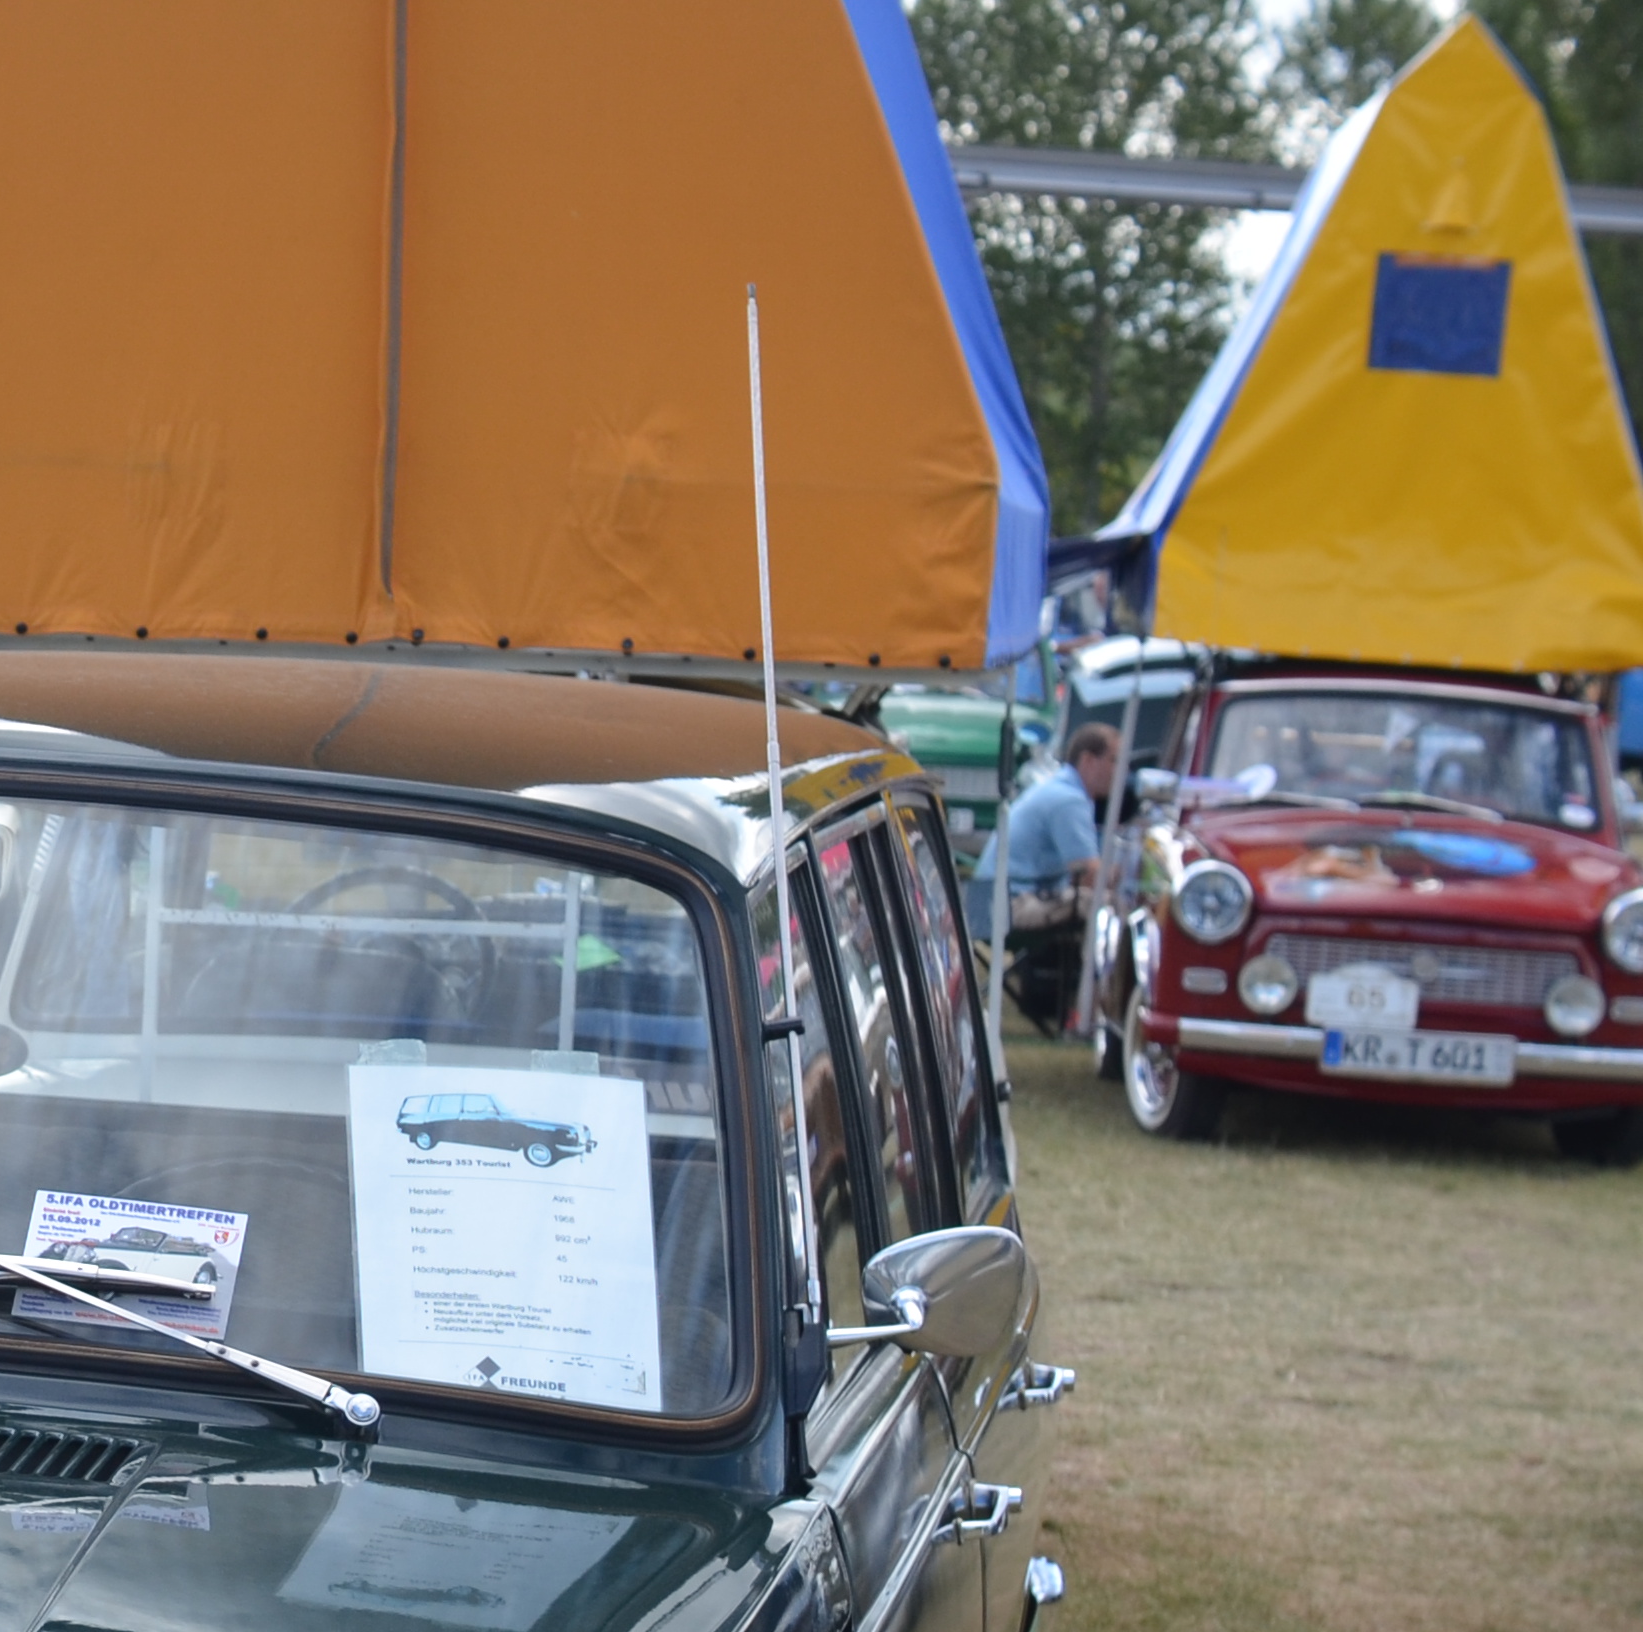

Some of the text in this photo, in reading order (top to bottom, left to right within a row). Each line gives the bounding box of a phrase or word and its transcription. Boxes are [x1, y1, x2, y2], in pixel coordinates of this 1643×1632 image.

[1344, 1034, 1487, 1071] KR T 601
[407, 1157, 452, 1167] Wartburg
[477, 1159, 511, 1168] Tourist
[409, 1187, 453, 1196] Hersteller:
[552, 1195, 575, 1204] AWE
[46, 1194, 84, 1207] 5.IFA
[89, 1198, 236, 1225] OLDTIMERTREFFEN
[410, 1207, 445, 1216] Baujahr:
[42, 1213, 101, 1227] 15.09.2012
[554, 1215, 575, 1224] 1968
[411, 1226, 453, 1235] Hubraum:
[412, 1245, 427, 1254] PS:
[413, 1265, 517, 1278] Höchstgeschwindigkeit:
[558, 1275, 598, 1286] 122 km/h
[414, 1290, 481, 1300] Besonderheiten:
[527, 1305, 552, 1314] Tourist
[467, 1373, 566, 1392] IFA FREUNDE
